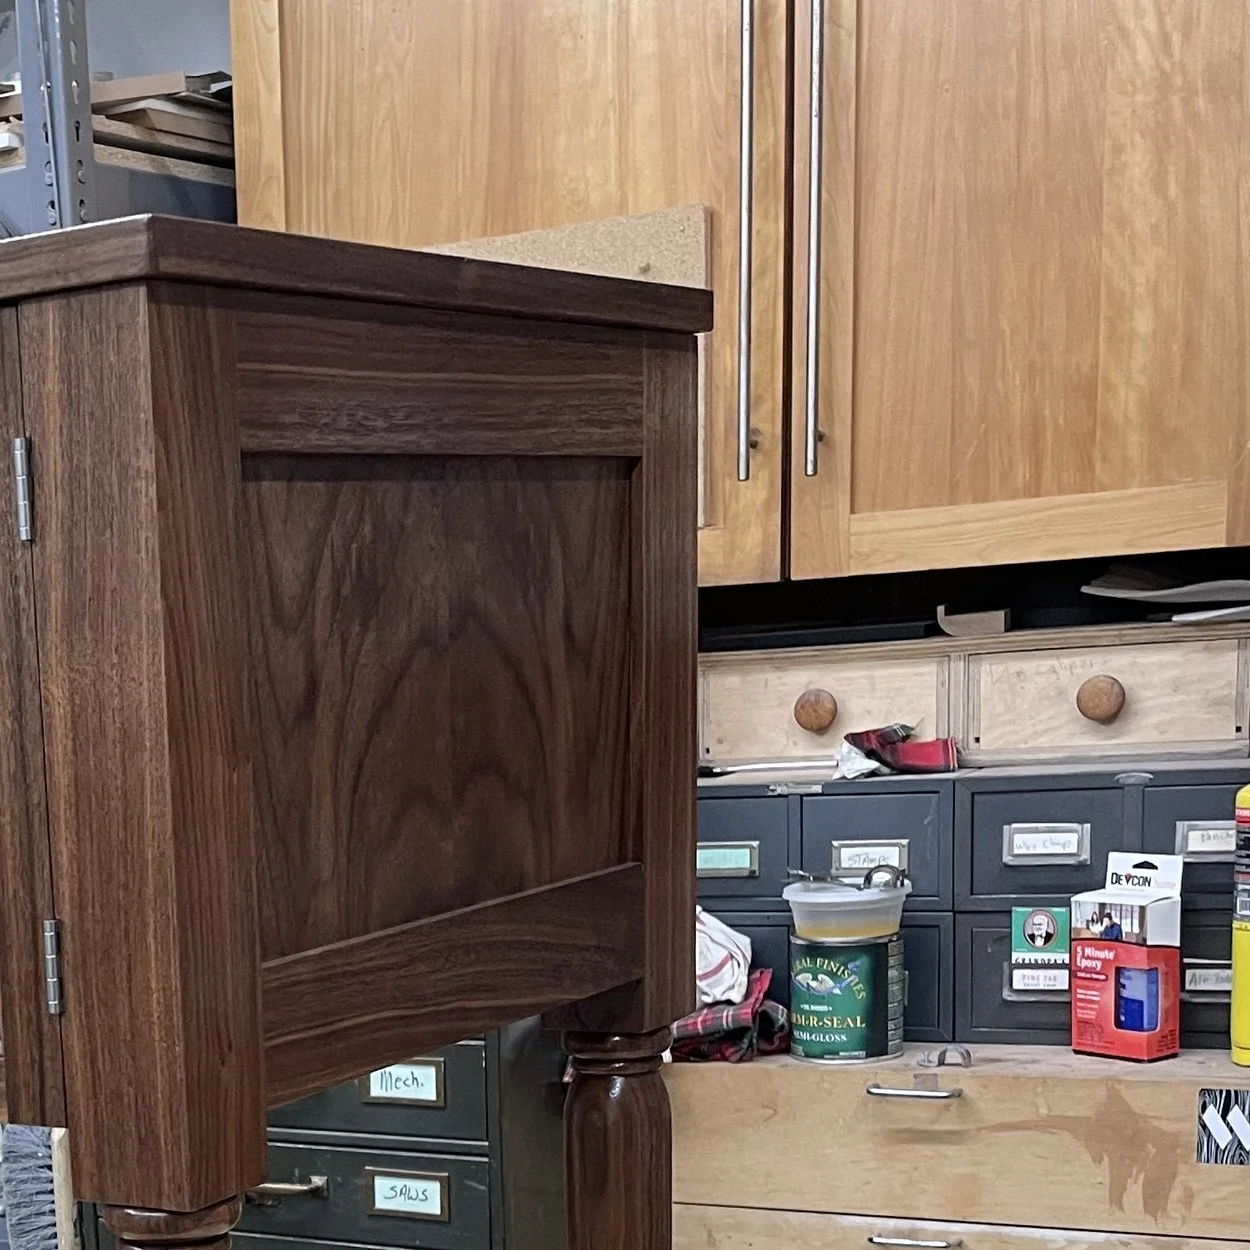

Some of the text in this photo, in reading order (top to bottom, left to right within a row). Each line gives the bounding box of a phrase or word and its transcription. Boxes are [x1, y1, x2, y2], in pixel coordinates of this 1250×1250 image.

[1110, 872, 1152, 888] DEVCON
[1076, 945, 1114, 960] 5 Minute
[1076, 955, 1102, 971] Epoxy
[380, 1069, 424, 1092] Mech.
[384, 1184, 428, 1202] SAWS
